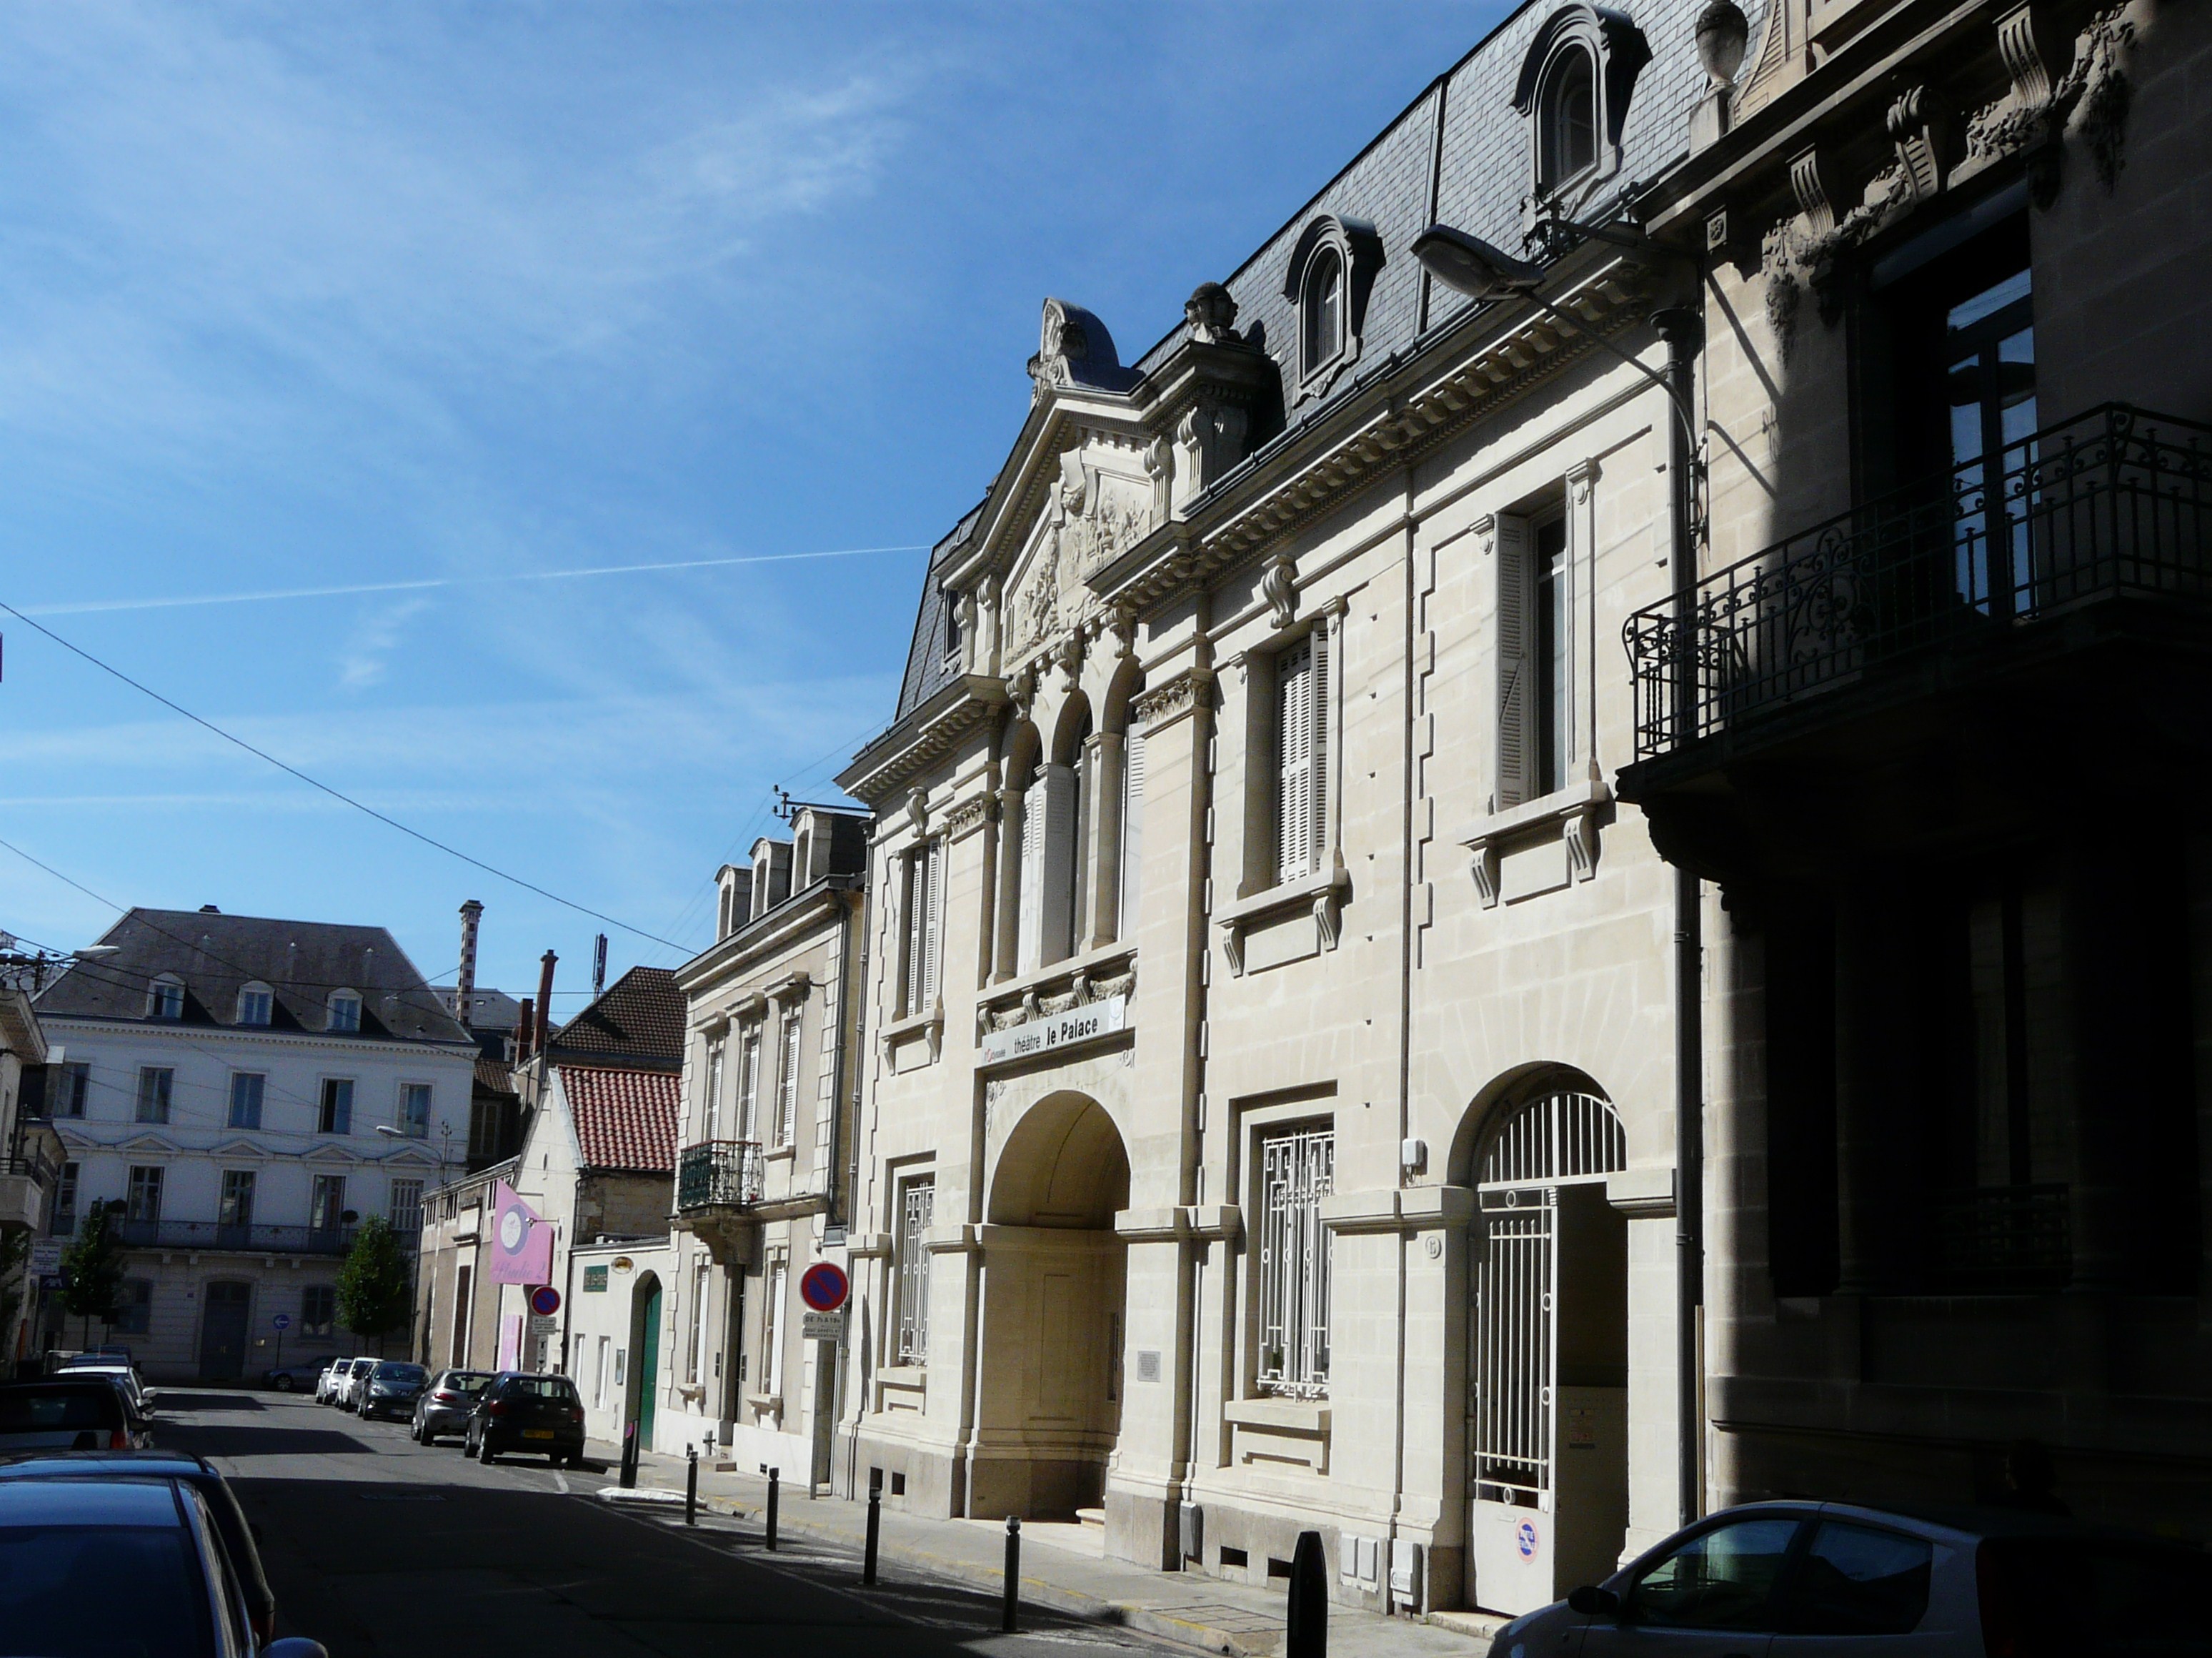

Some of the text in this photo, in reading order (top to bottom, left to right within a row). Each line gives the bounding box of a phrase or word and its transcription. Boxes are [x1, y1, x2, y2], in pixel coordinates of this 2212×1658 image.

[1014, 1035, 1041, 1054] théâtre
[1047, 1026, 1057, 1046] le
[1061, 1017, 1098, 1042] Palace
